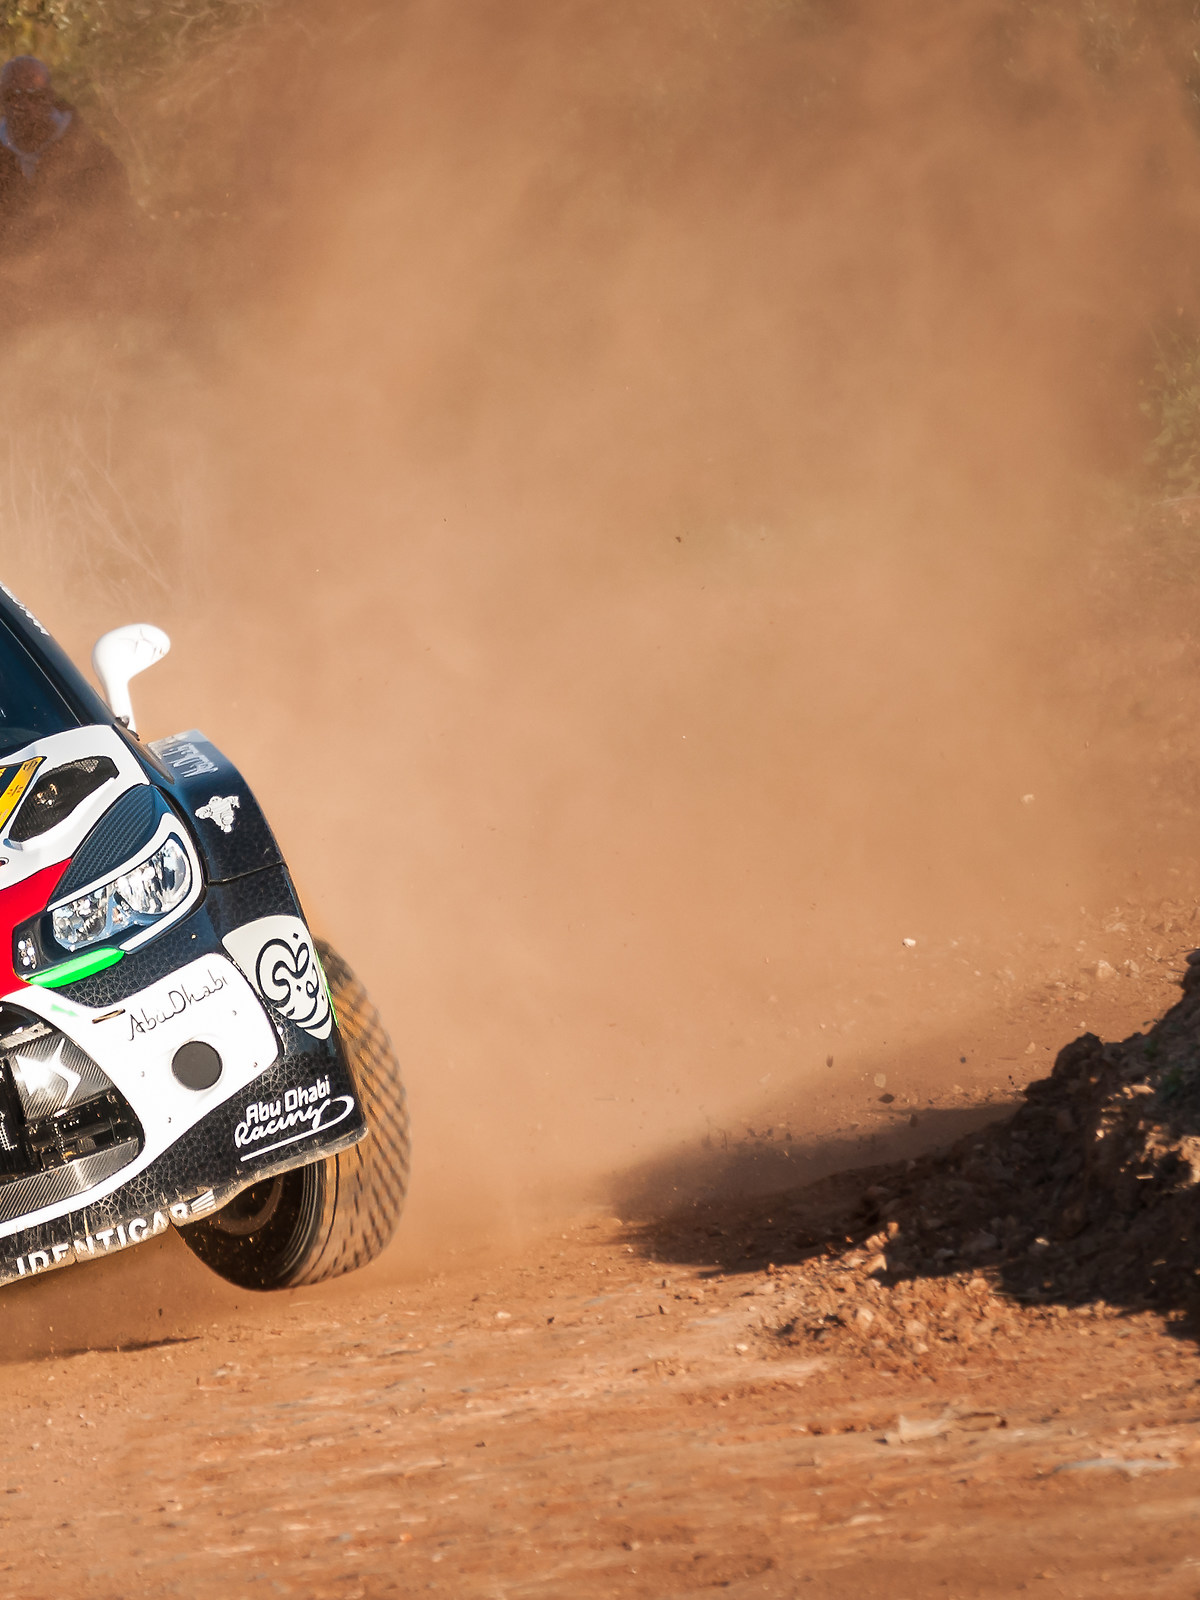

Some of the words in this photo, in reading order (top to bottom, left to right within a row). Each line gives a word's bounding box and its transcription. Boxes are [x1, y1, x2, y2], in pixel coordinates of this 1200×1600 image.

[234, 1099, 332, 1150] Racing
[246, 1099, 282, 1127] Abu
[284, 1075, 331, 1110] Dhabi
[16, 1202, 191, 1276] IDENTICAR
